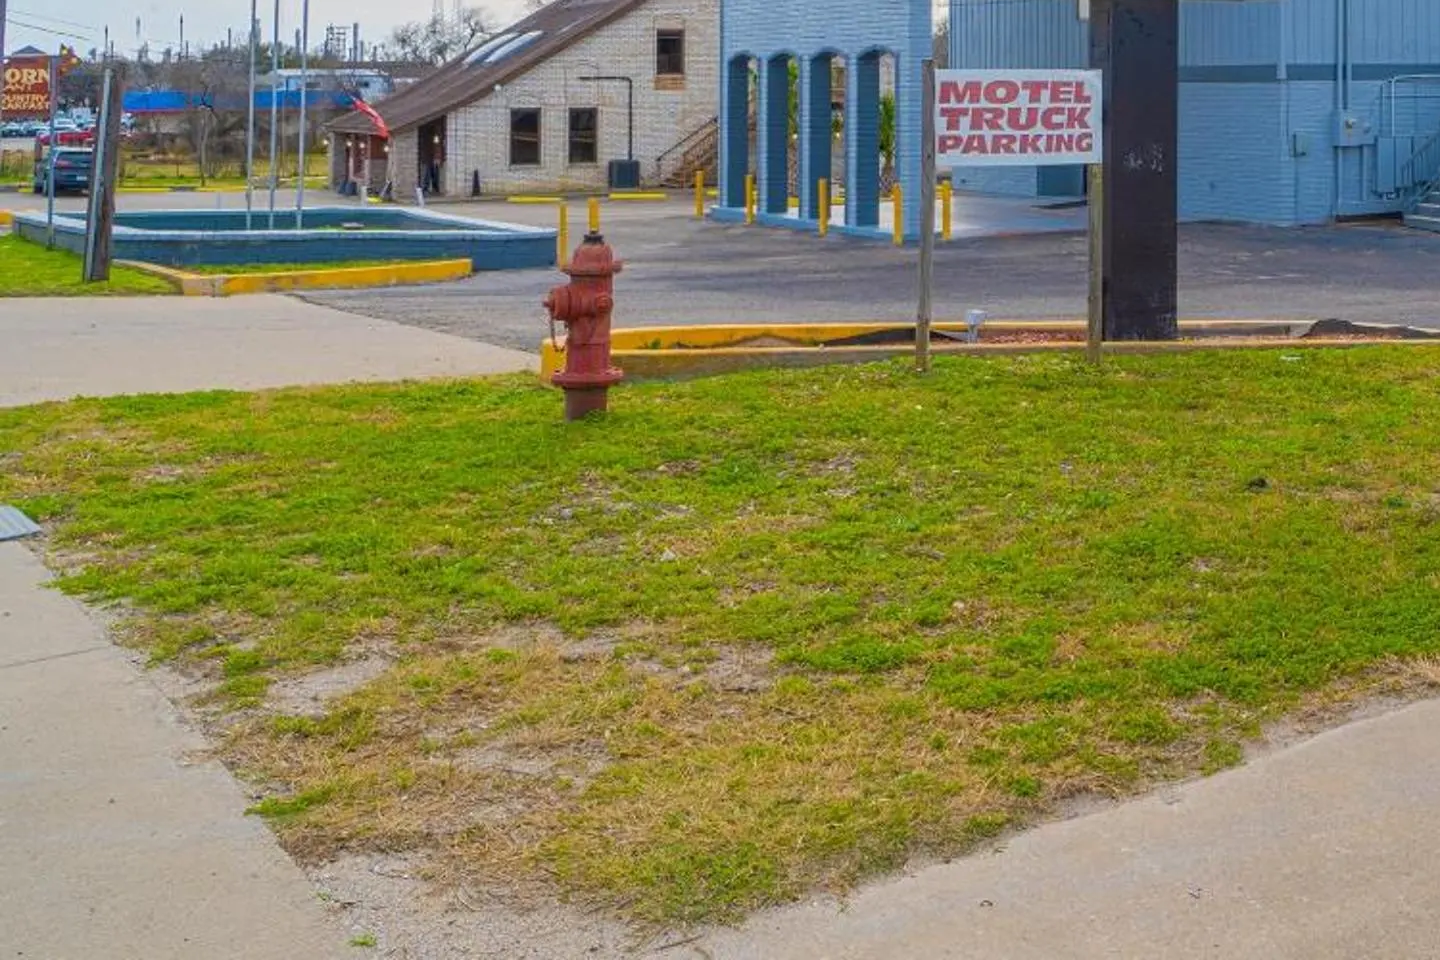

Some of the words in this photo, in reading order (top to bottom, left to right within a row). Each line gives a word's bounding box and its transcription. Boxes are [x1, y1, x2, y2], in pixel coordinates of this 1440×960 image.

[938, 79, 1092, 105] MOTEL
[939, 107, 1091, 131] TRUCK
[937, 132, 1093, 154] PARKING
